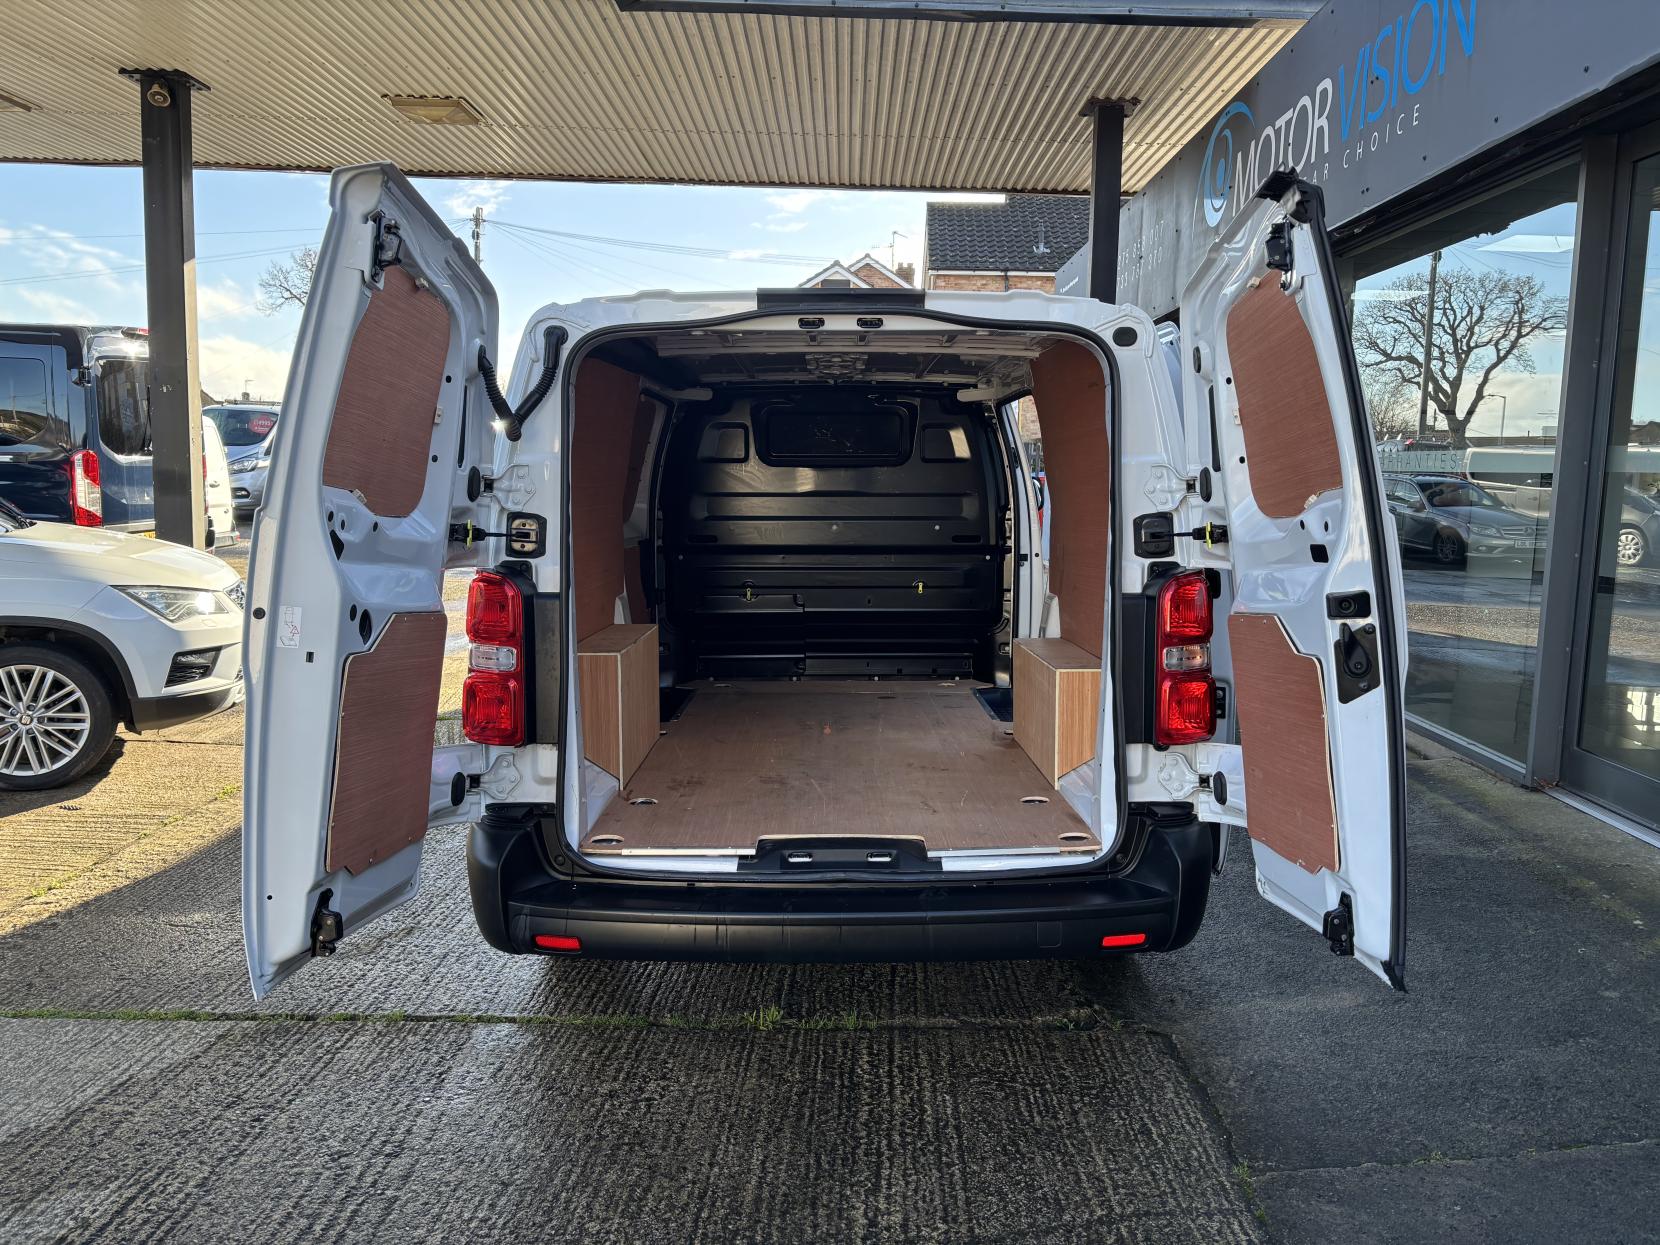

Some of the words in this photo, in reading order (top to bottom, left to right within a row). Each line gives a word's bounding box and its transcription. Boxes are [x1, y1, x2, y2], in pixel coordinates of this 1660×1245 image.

[1233, 78, 1332, 216] MOTOR
[1339, 0, 1477, 142] VISION
[1343, 103, 1420, 169] CHOICE
